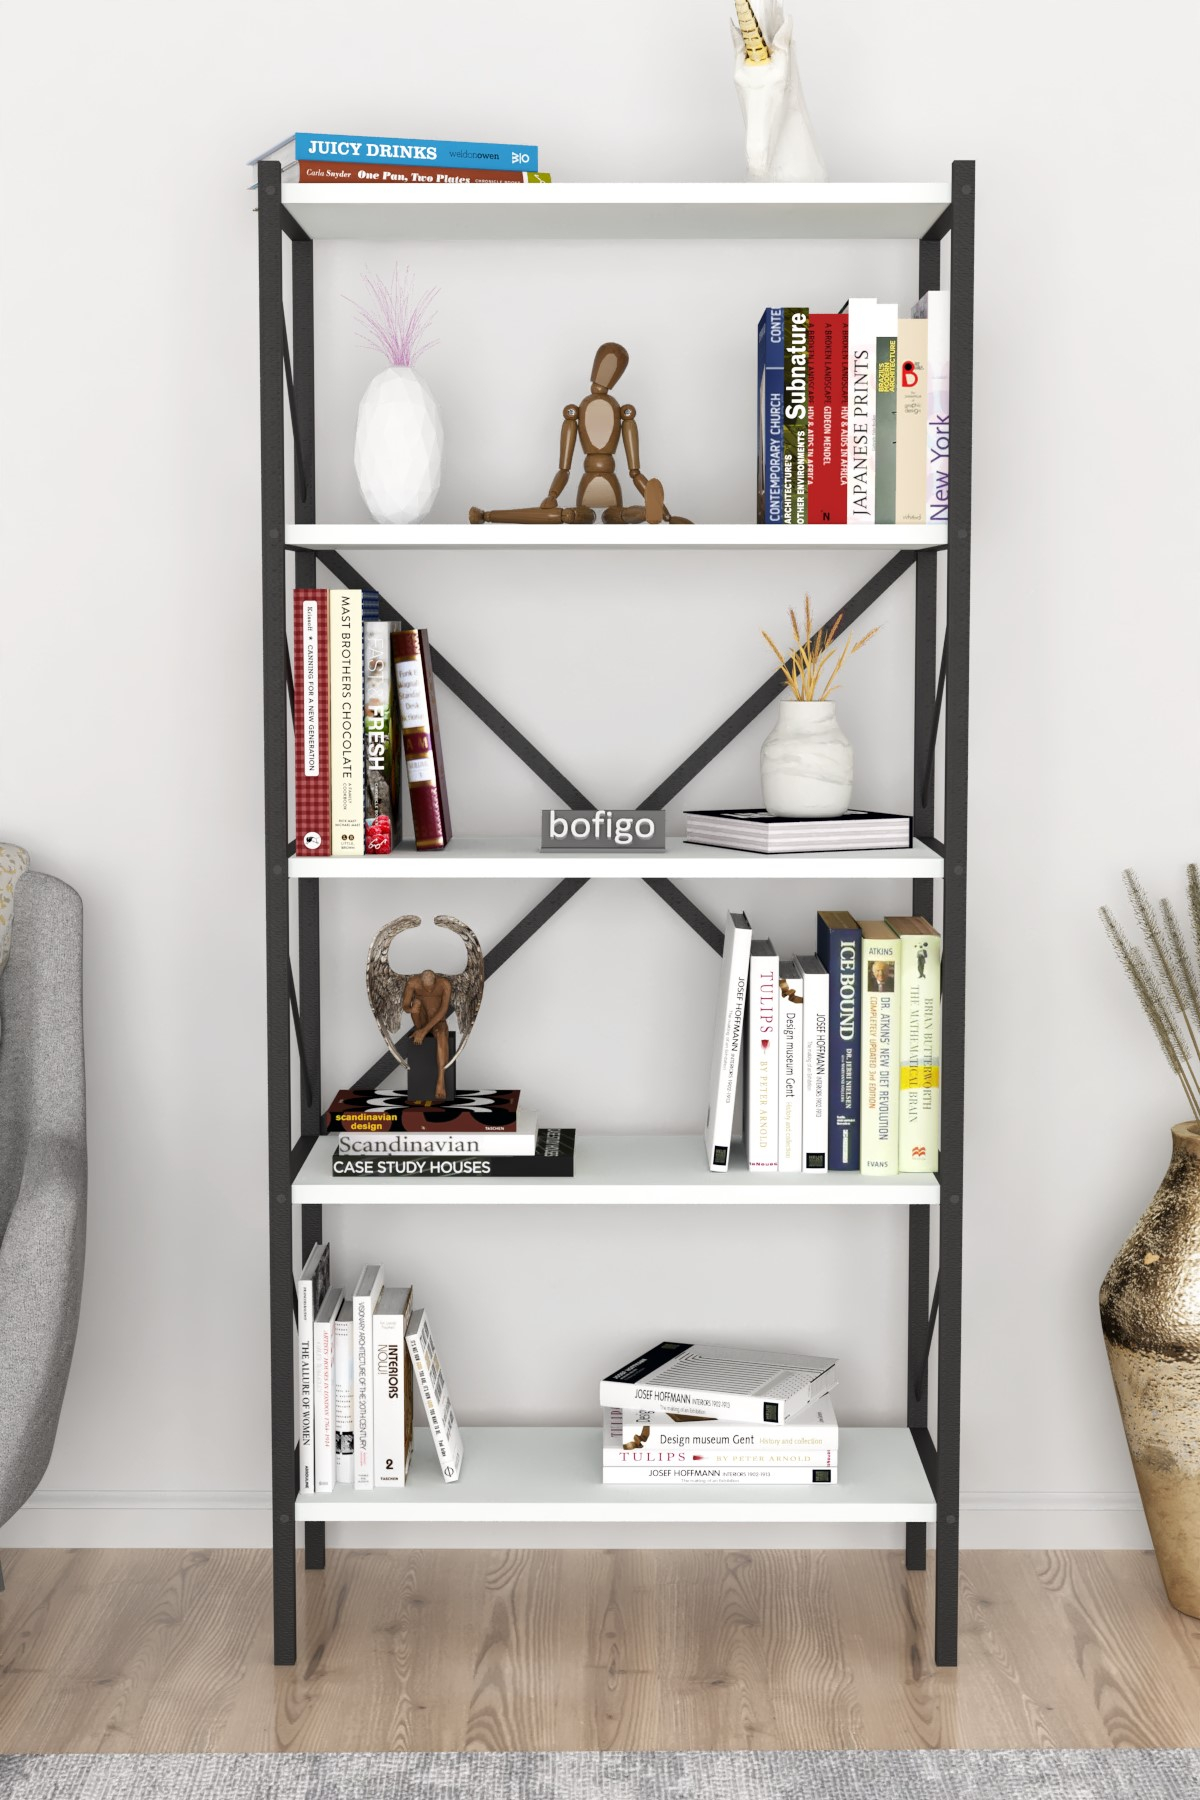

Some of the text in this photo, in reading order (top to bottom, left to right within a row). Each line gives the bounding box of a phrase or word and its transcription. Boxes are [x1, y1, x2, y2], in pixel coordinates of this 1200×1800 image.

[308, 140, 437, 161] JUICY DRINKS
[306, 168, 352, 179] Carla Snyder
[357, 170, 471, 183] One Pan, Two Plates
[770, 309, 782, 344] CONTE
[824, 330, 832, 360] BROKEN
[784, 312, 807, 420] Subnature
[824, 361, 832, 404] LANDSCAPE
[823, 406, 832, 466] GIDEON MENDEL
[853, 350, 871, 515] JAPANESE PRINTS
[769, 393, 781, 522] CONTEMPORARY CHURCH
[929, 414, 950, 520] New York
[784, 454, 793, 524] ARCHITECTURE'S
[796, 430, 805, 524] OTHER ENVIRONMENTS
[341, 595, 352, 778] MAST BROTHERS CHOCOLATE
[368, 704, 385, 771] FRESH
[549, 810, 656, 845] bofigo
[869, 948, 893, 956] ATKINS
[736, 976, 745, 1001] JOSEF
[839, 940, 856, 1041] ICE BOUND
[731, 1003, 743, 1052] HOFFMANN
[783, 1012, 796, 1040] Design
[816, 1013, 826, 1033] JOSEF
[869, 996, 878, 1038] COMPLETELY
[760, 971, 774, 1148] TULIPS BY PETER ARNOLD
[786, 1042, 794, 1076] museum
[816, 1034, 826, 1075] HOFFMANN
[869, 1039, 877, 1069] UPDATED
[879, 997, 891, 1140] DR. ATKINS' NEW DIET REVOLUTION
[909, 986, 920, 1123] THE MATHEMATICAL BRAIN
[922, 998, 934, 1110] BRIAN BUTTERWORTH
[786, 1078, 796, 1098] Gent
[869, 1082, 877, 1109] EDITION
[335, 1113, 398, 1121] scandinavian
[350, 1122, 383, 1132] design
[339, 1135, 480, 1153] Scandinavian
[333, 1161, 491, 1174] CASE STUDY HOUSES
[867, 1160, 888, 1168] EVANS
[358, 1332, 366, 1377] ARCHITECTURE
[377, 1344, 388, 1375] NOW!
[359, 1377, 366, 1386] OF
[388, 1344, 399, 1399] INTERIORS
[302, 1341, 311, 1446] THE ALLURE OF WOMEN
[634, 1388, 653, 1400] JOSEF
[654, 1391, 691, 1404] HOFFMANN
[359, 1418, 367, 1450] CENTURY
[660, 1434, 690, 1447] Design
[692, 1436, 730, 1445] museum
[732, 1434, 754, 1445] Gent
[759, 1438, 780, 1446] History
[385, 1458, 394, 1470] 2
[619, 1452, 686, 1462] TULIPS
[649, 1469, 672, 1477] JOSEF
[673, 1469, 721, 1477] HOFFMANN
